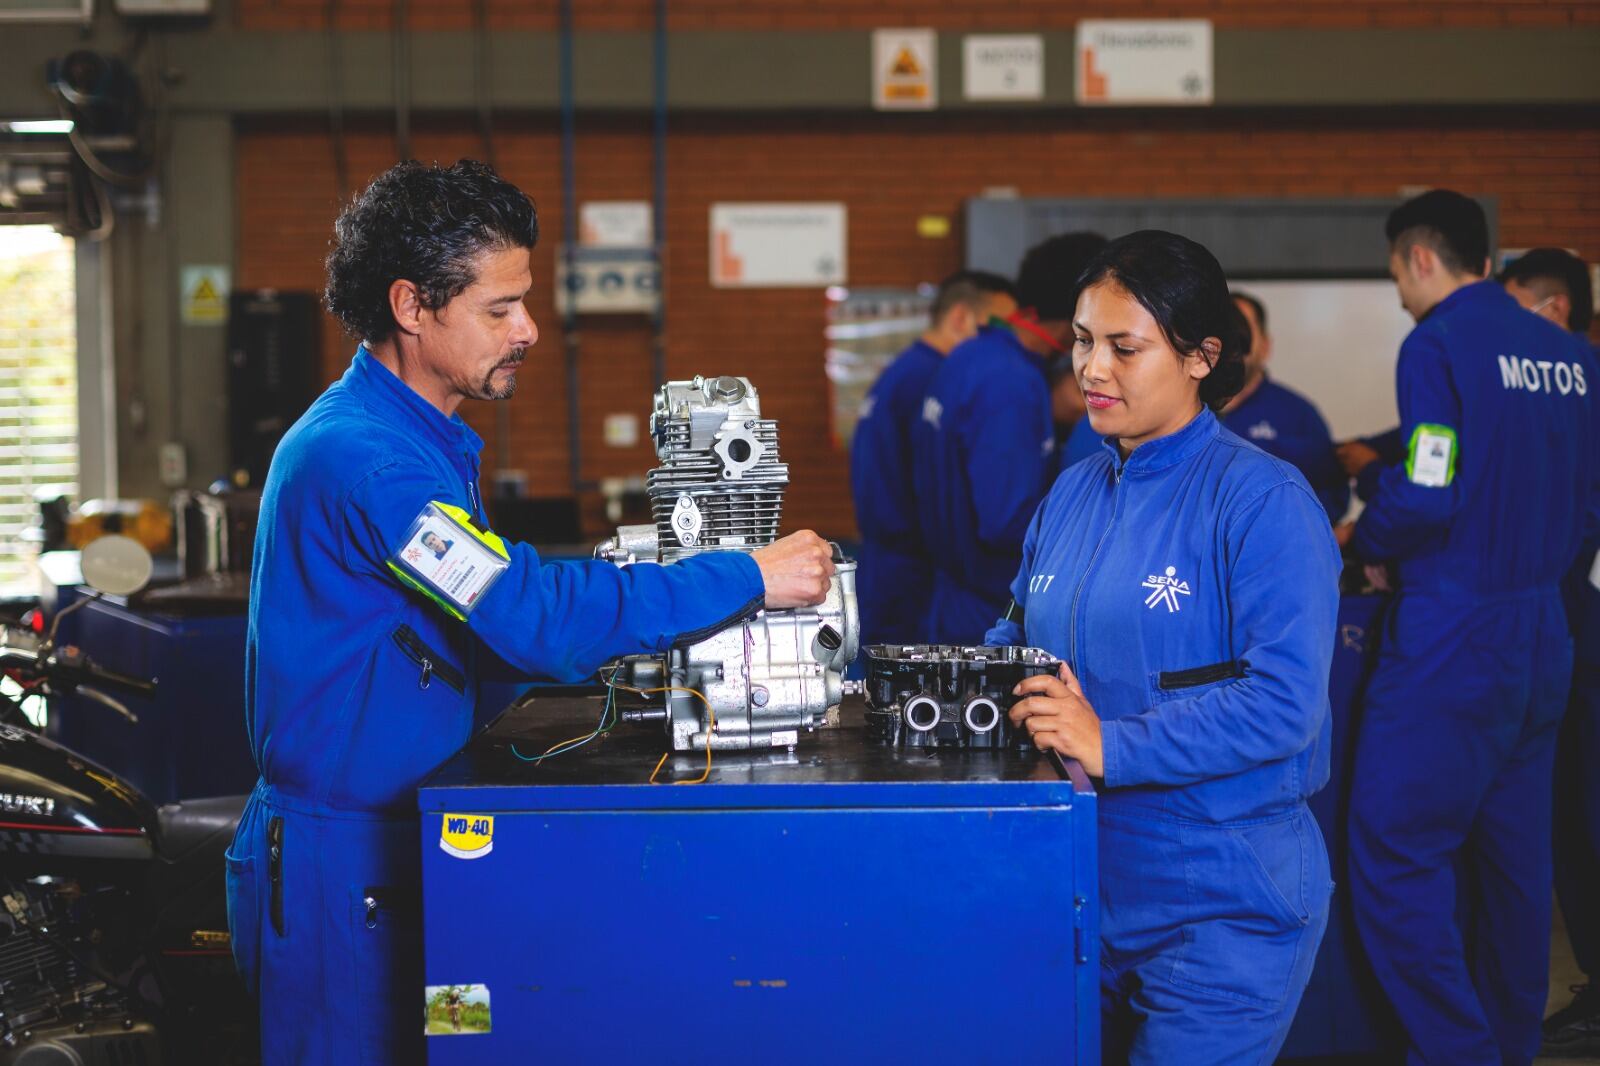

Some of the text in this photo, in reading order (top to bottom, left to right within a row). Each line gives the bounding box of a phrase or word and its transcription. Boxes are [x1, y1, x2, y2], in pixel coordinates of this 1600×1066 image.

[1498, 354, 1588, 396] MOTOS
[1147, 575, 1190, 591] SENA
[447, 817, 490, 836] WD-40
